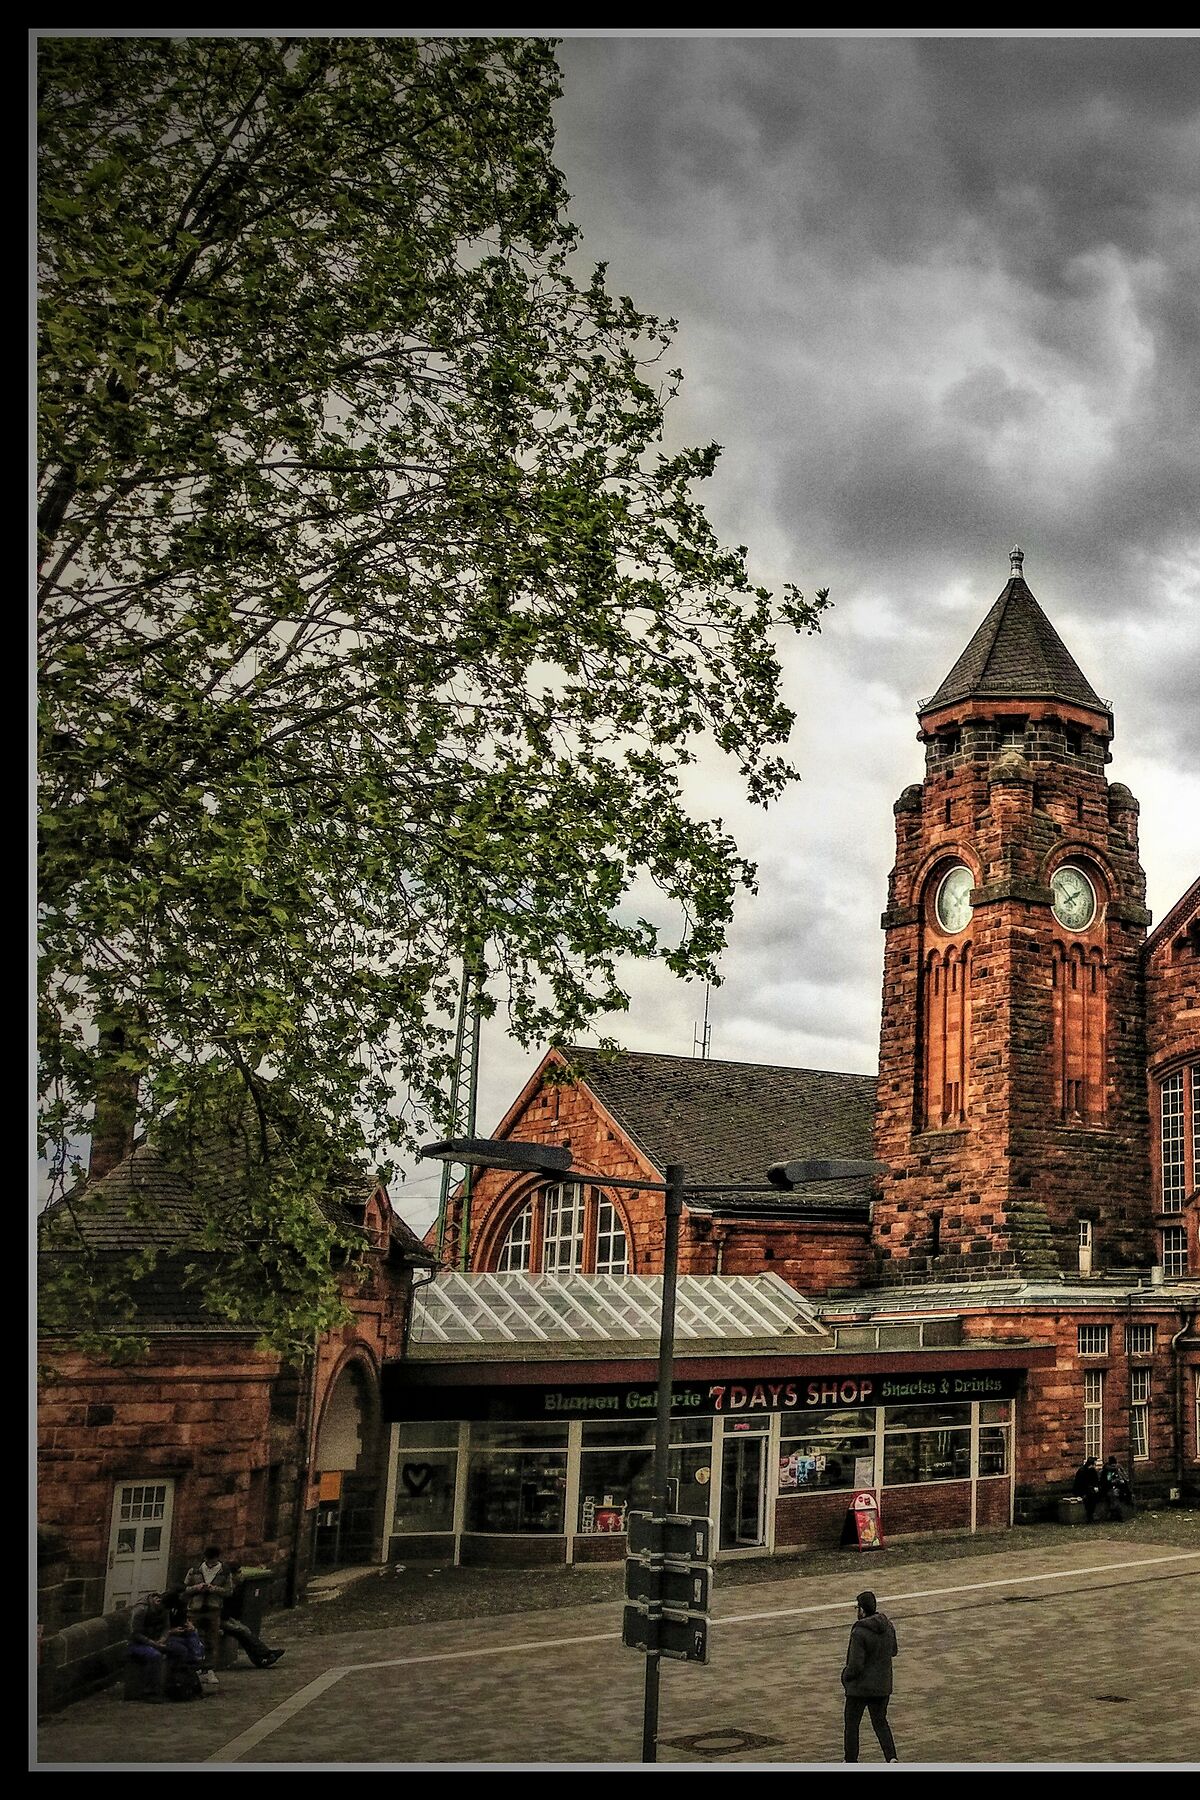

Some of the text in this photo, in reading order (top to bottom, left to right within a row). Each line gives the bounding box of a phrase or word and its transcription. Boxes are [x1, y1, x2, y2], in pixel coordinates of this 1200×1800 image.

[544, 1376, 1002, 1410] Blumen Galrie 7 DAYS SHOP Snacks & Drinks
